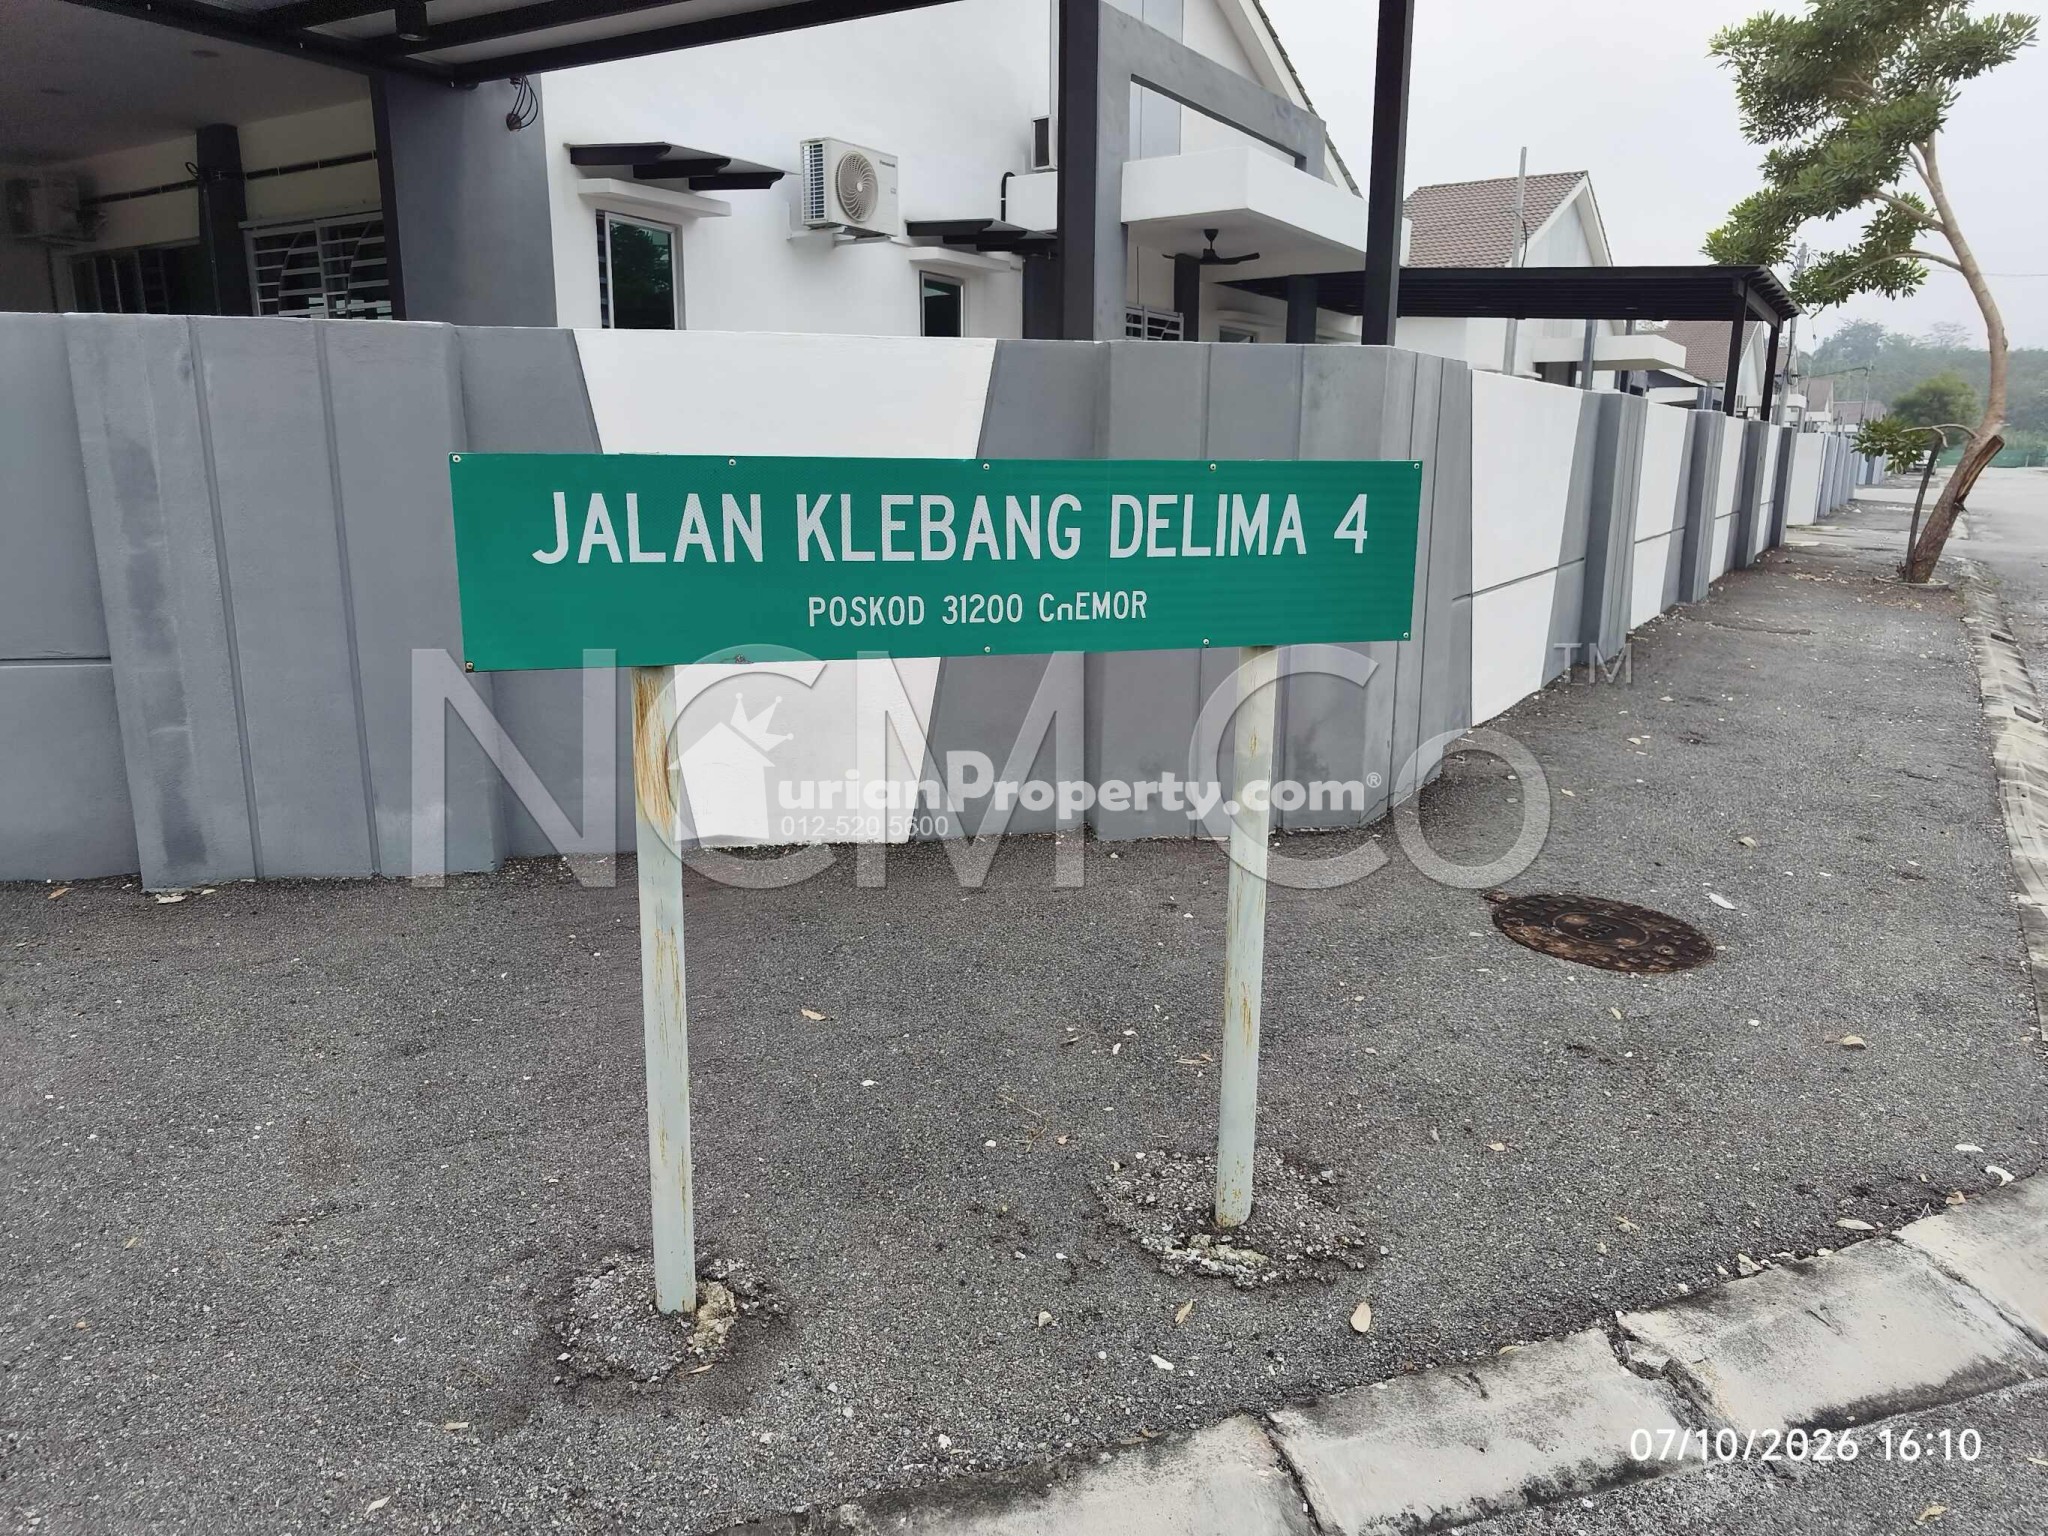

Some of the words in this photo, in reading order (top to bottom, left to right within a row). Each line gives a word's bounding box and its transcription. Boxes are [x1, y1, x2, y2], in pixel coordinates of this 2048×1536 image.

[531, 491, 764, 565] JALAN
[795, 493, 1083, 563] KLEBANG
[1109, 493, 1307, 559] DELIMA
[1333, 493, 1368, 554] 4
[808, 595, 926, 627] POSKOD
[941, 593, 1023, 625] 31200
